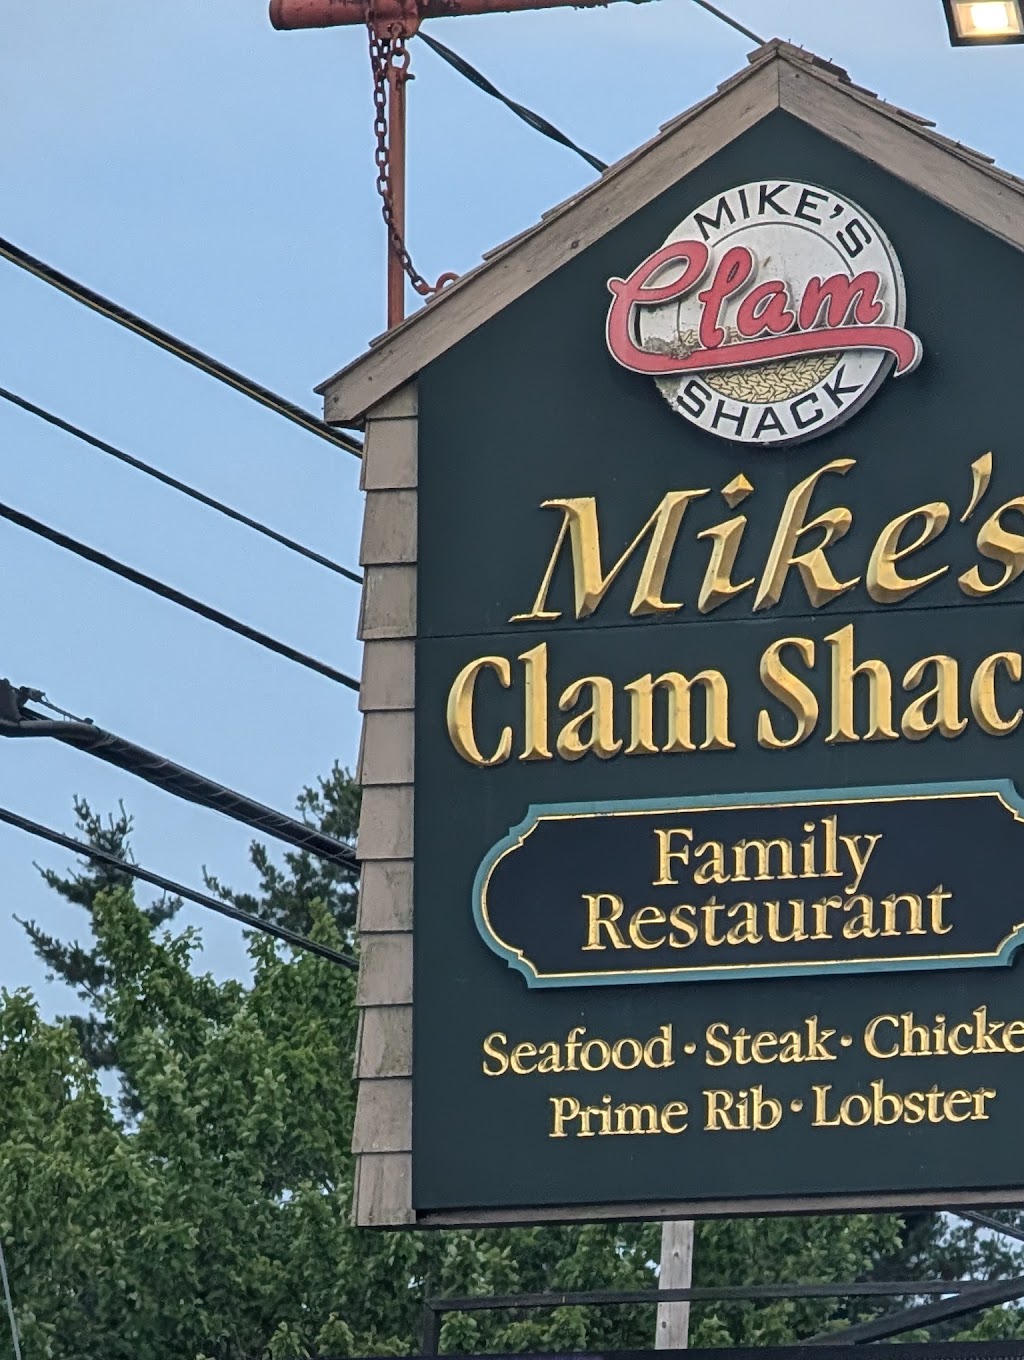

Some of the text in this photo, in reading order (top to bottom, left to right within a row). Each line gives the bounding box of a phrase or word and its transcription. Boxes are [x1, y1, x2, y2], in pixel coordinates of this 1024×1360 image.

[692, 183, 873, 259] MIKE'S
[606, 240, 922, 376] Clam
[675, 363, 863, 439] SHACK
[446, 641, 736, 768] Clam
[651, 815, 882, 895] Family
[581, 883, 954, 952] Restaurant
[481, 1023, 675, 1077] Seafood
[704, 1014, 838, 1068] Steak
[548, 1079, 997, 1138] Prime Rib Lobster
